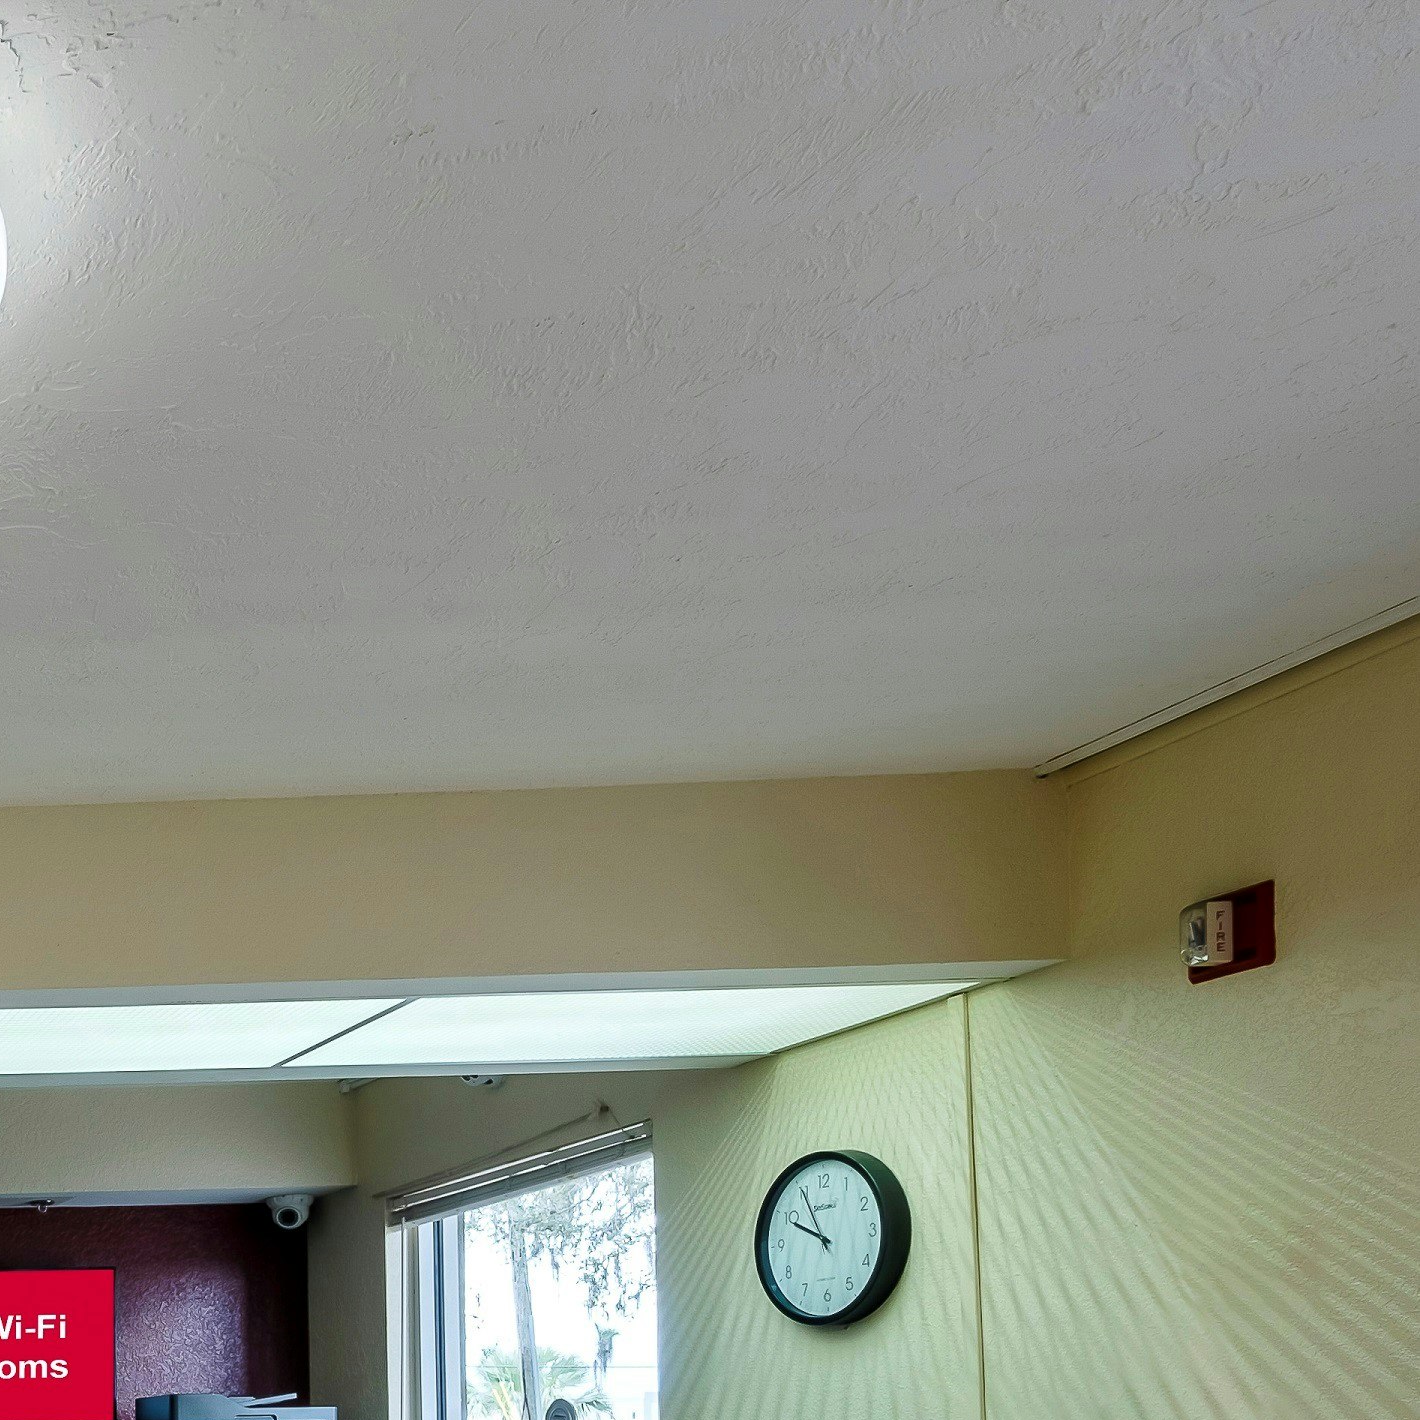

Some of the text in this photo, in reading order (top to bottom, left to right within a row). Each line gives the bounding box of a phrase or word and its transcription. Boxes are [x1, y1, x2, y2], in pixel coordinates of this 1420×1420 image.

[1216, 911, 1226, 952] FIRE
[818, 1173, 830, 1188] 12
[844, 1177, 849, 1191] 1
[860, 1197, 869, 1211] 2
[784, 1210, 800, 1225] 10
[868, 1222, 877, 1237] 3
[777, 1239, 785, 1253] 9
[862, 1253, 870, 1267] 4
[785, 1265, 793, 1280] 8
[801, 1282, 809, 1297] 7
[845, 1277, 854, 1291] 5
[823, 1289, 832, 1302] 6
